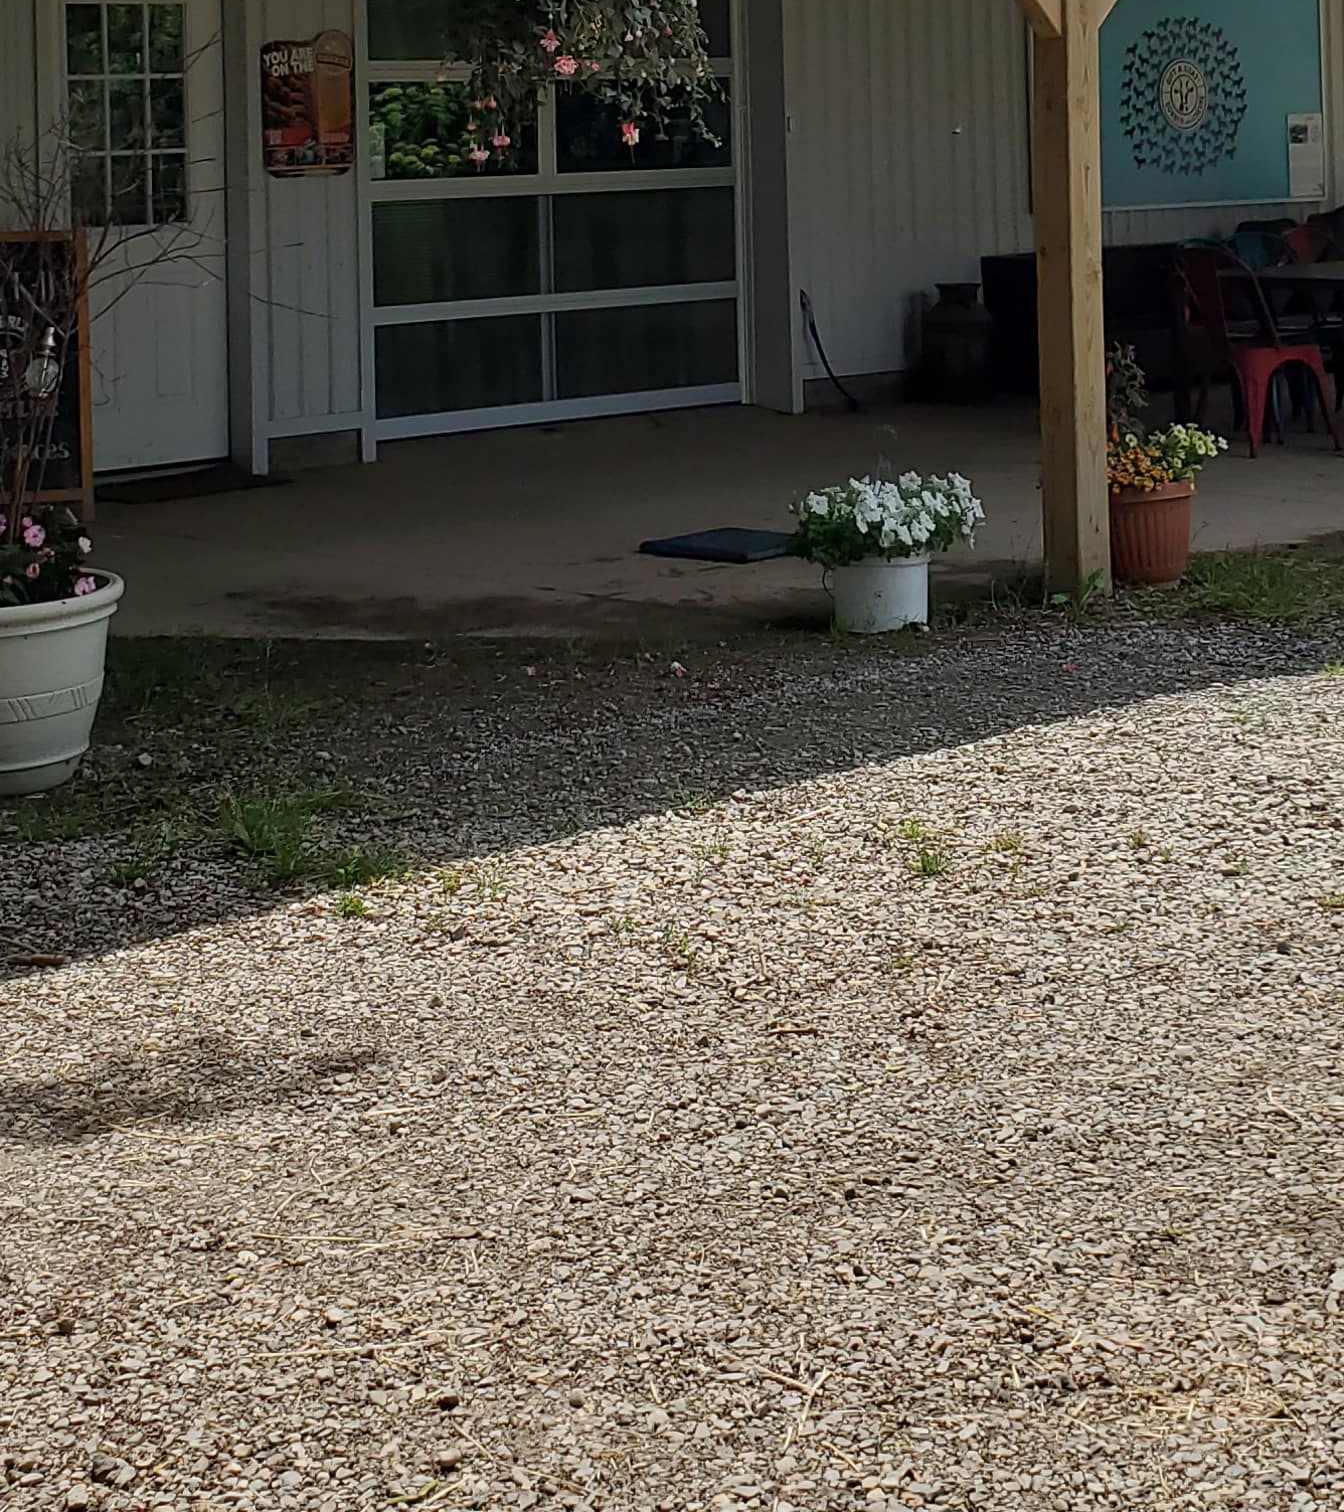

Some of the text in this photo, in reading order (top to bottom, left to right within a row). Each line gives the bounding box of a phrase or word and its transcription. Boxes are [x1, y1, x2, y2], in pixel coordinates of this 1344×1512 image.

[263, 49, 288, 67] YOU
[290, 47, 313, 66] ARE
[272, 63, 289, 77] ON
[293, 60, 314, 74] THE
